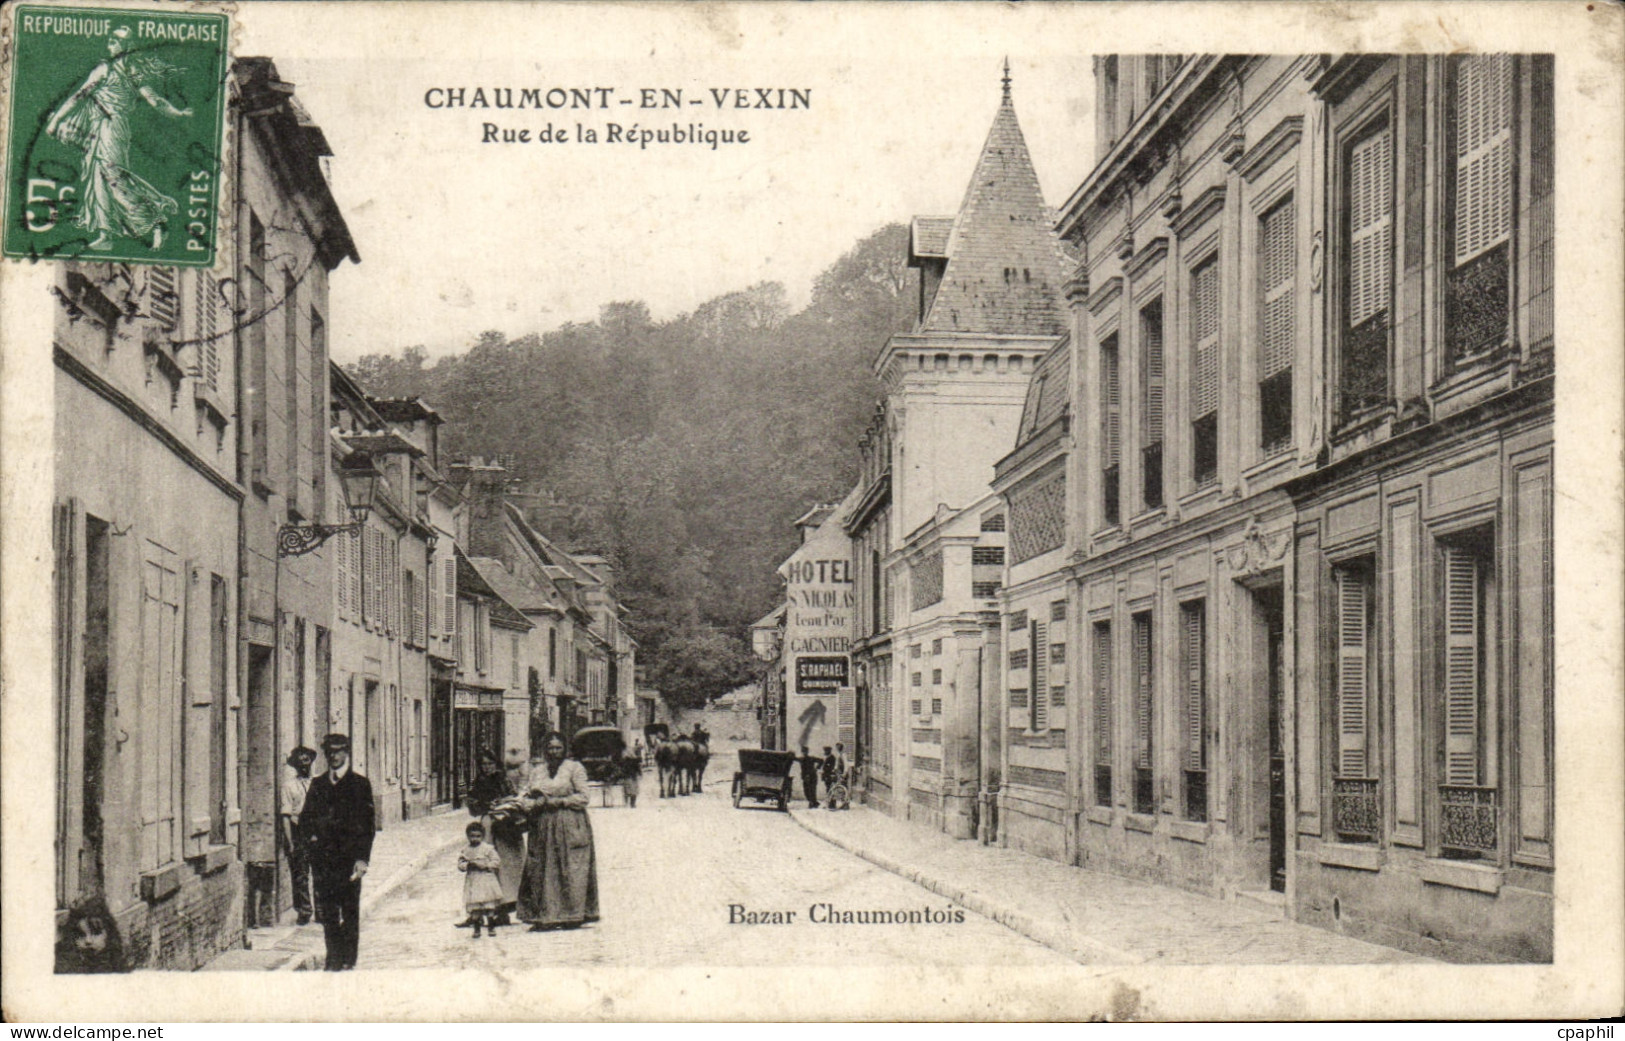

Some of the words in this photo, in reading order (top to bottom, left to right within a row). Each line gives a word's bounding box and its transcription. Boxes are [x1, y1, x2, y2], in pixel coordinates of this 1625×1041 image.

[138, 20, 218, 42] FRANÇAISE
[187, 170, 210, 251] POSTES
[788, 560, 854, 584] HOTEL
